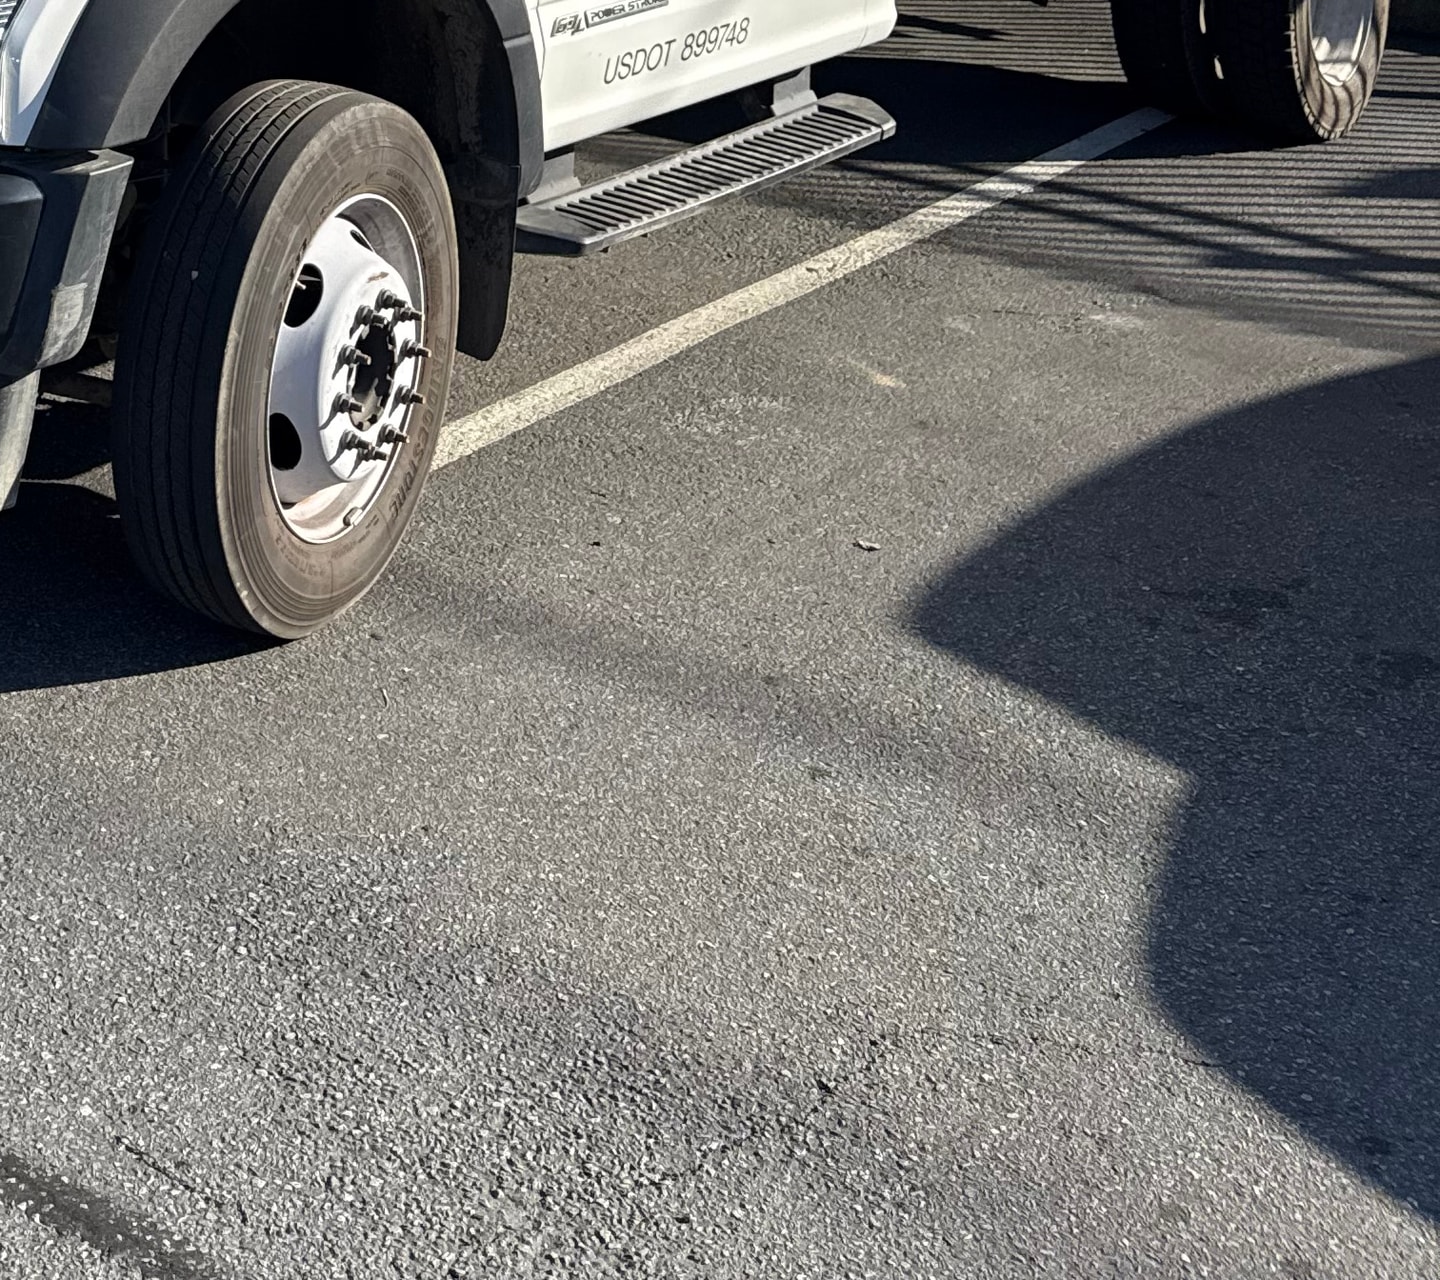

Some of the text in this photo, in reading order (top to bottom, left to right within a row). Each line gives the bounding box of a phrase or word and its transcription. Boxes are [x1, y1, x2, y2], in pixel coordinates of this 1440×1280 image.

[590, 4, 626, 22] POWER
[603, 16, 751, 84] USDOT 899748
